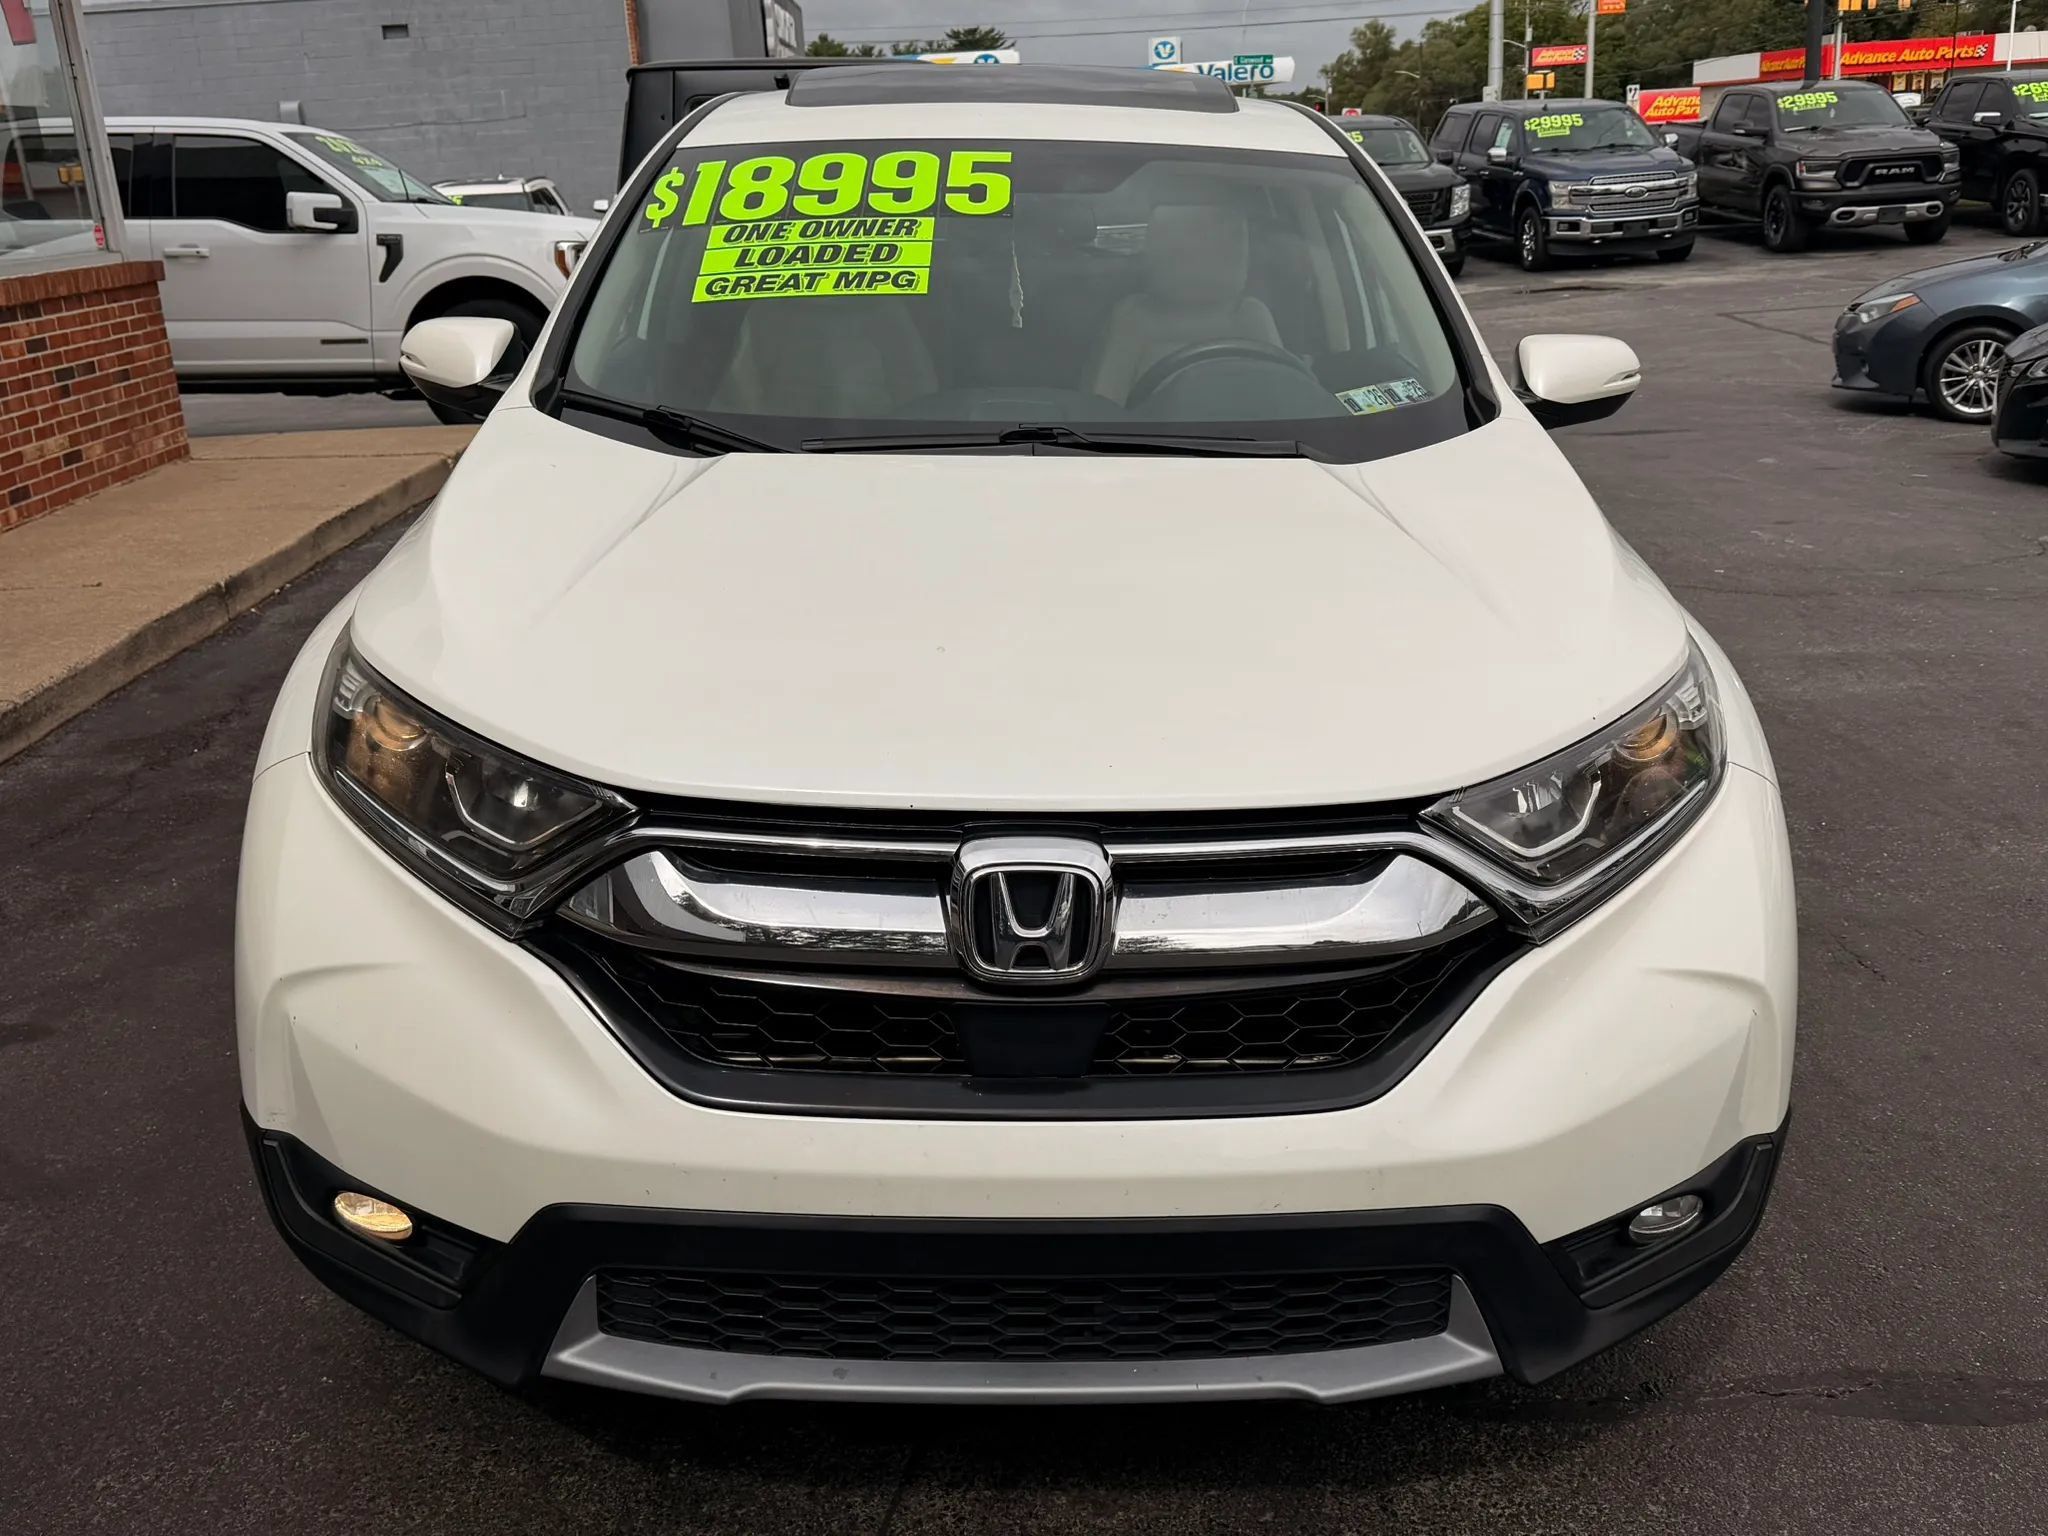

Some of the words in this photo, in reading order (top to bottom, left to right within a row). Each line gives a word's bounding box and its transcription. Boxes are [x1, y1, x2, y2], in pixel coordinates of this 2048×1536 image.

[1840, 52, 1896, 65] Advance
[1898, 49, 1936, 62] Auto
[1936, 46, 1975, 60] Parts
[1196, 63, 1274, 82] Valero
[1777, 91, 1838, 109] $29995
[1524, 113, 1584, 131] $29995
[1874, 166, 1915, 176] RAM
[645, 151, 1012, 229] $18995
[723, 221, 790, 245] ONE
[800, 217, 920, 240] OWNER
[733, 242, 903, 269] LOADED
[704, 271, 829, 298] GREAT
[832, 269, 920, 293] MPG
